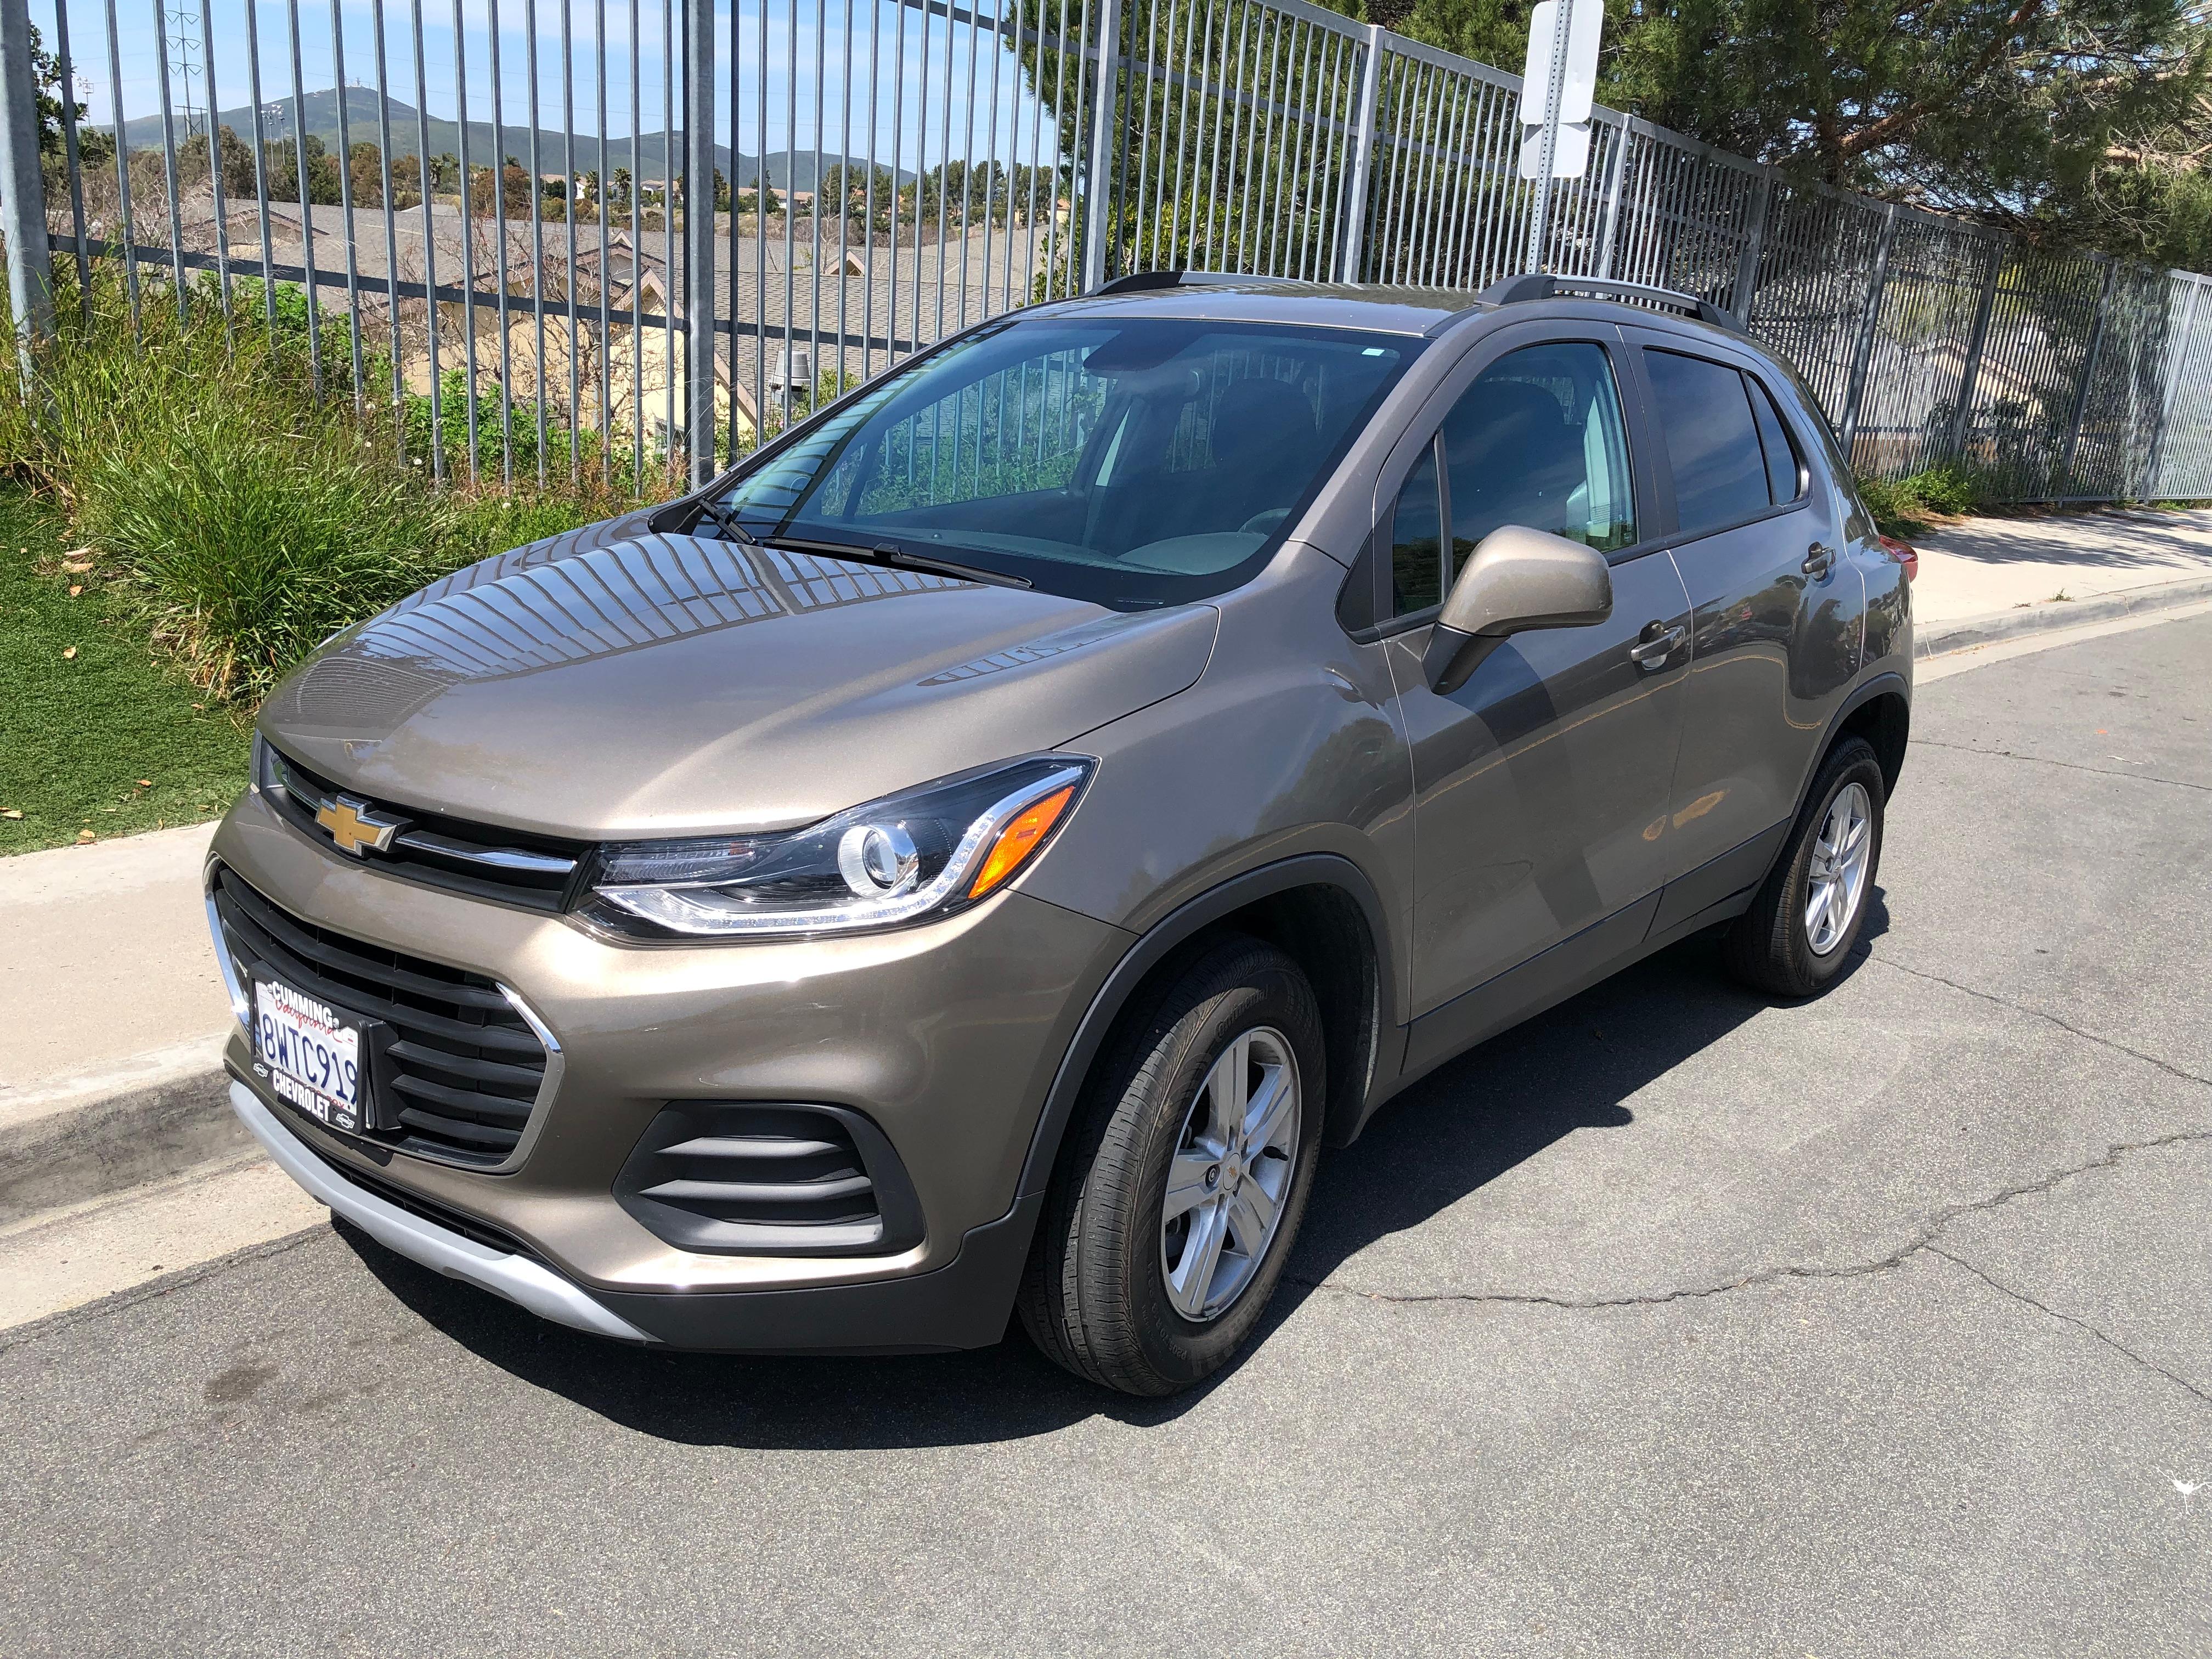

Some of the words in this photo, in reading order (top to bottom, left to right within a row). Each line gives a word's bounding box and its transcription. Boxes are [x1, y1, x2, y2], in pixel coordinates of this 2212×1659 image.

[272, 981, 332, 1028] CUMMING
[263, 1013, 358, 1105] 8WTC919
[273, 1069, 331, 1122] CHEVROLET
